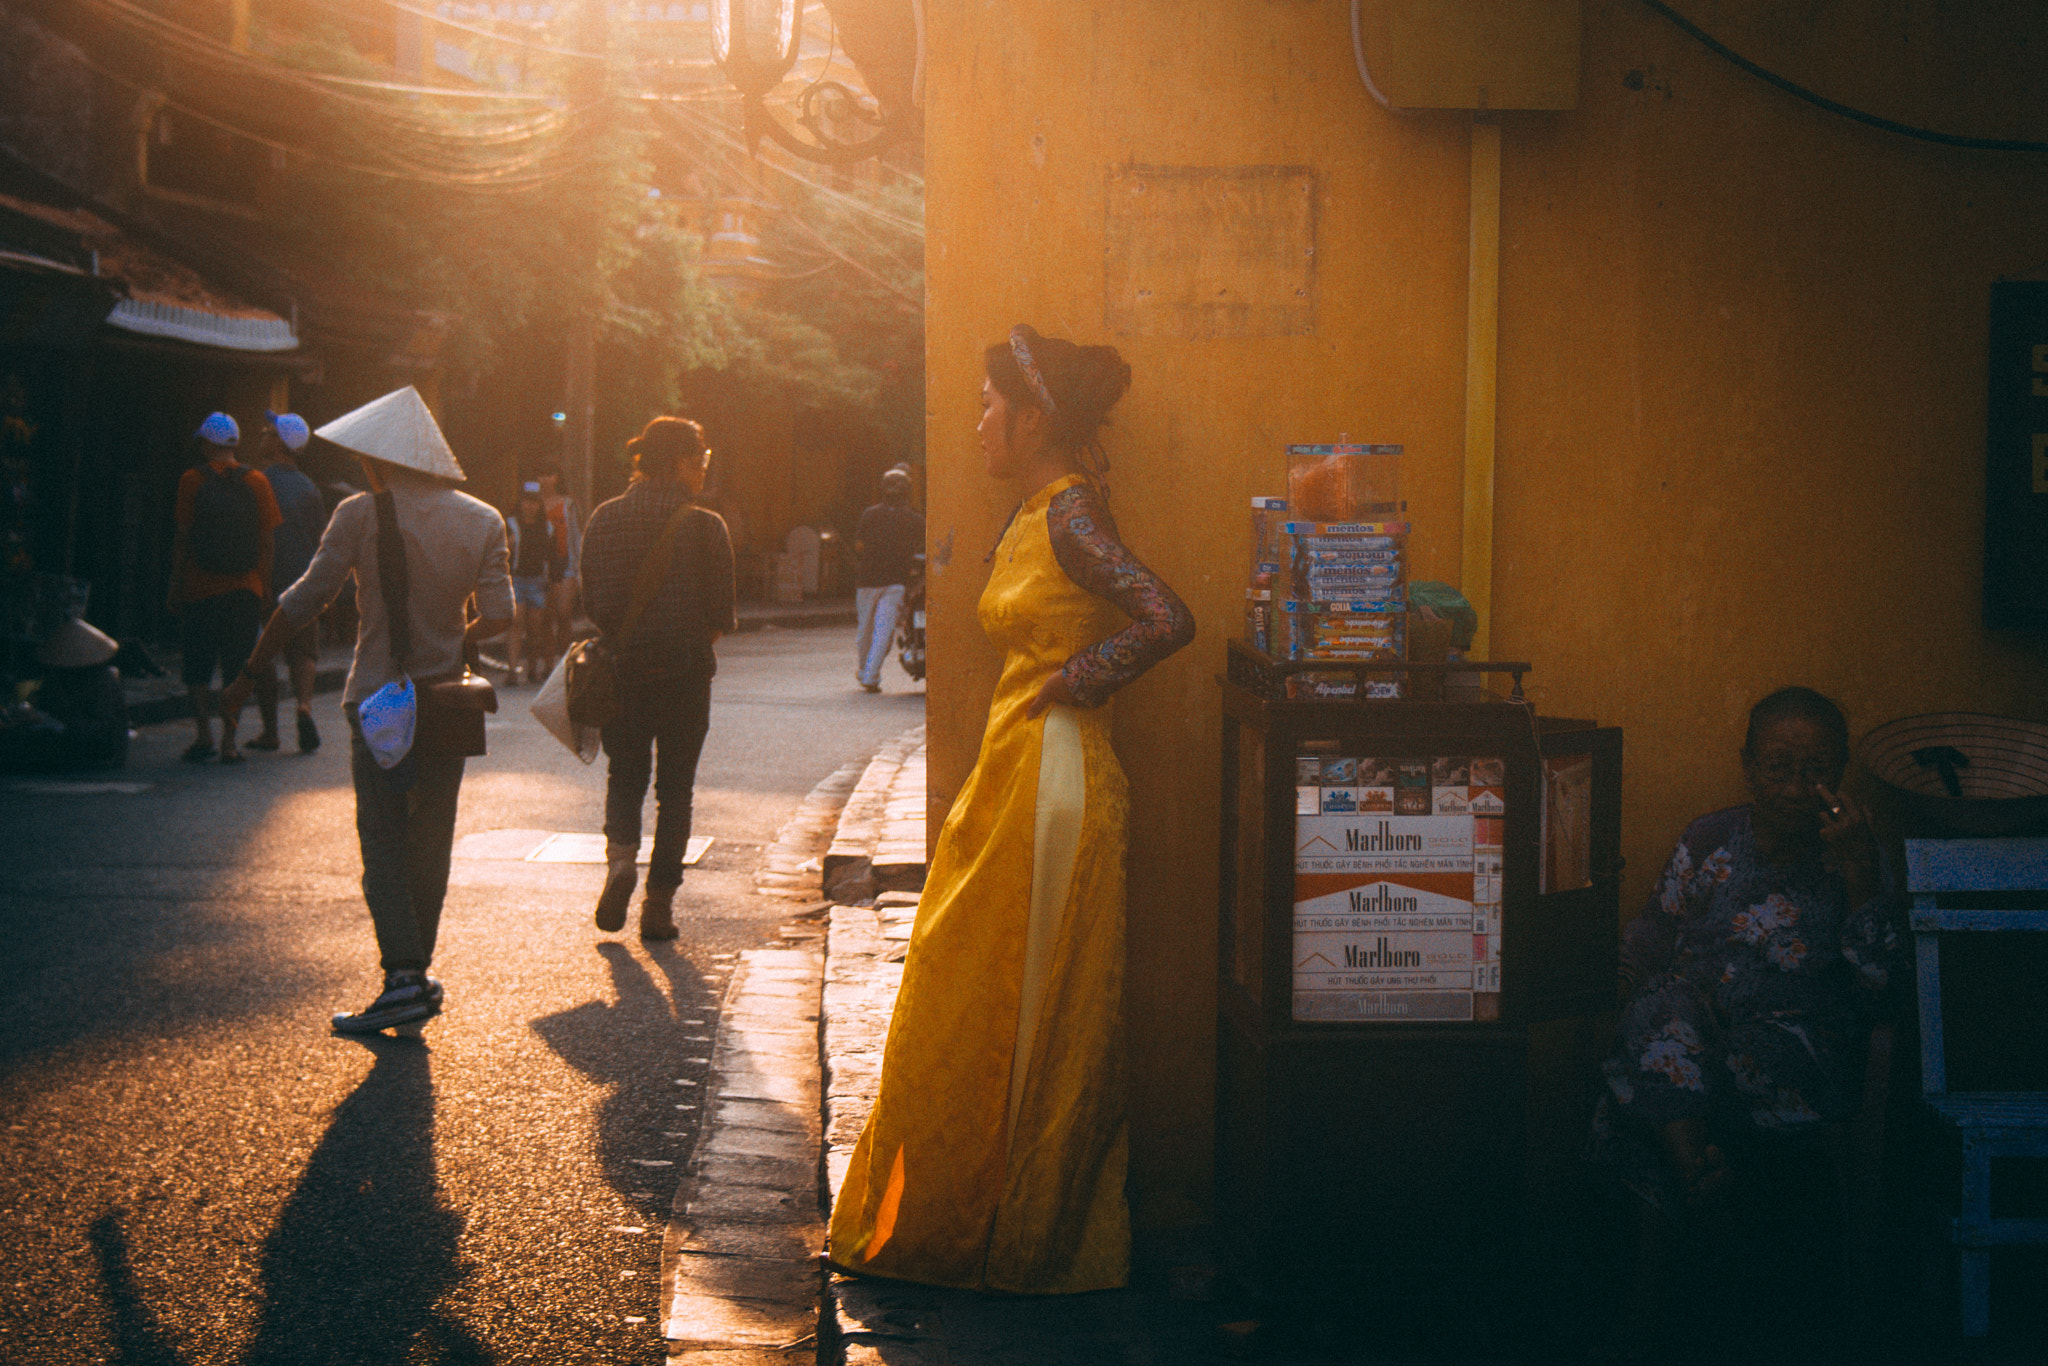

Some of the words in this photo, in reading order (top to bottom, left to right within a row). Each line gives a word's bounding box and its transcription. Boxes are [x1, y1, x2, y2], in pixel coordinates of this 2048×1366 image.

[1326, 524, 1374, 533] mentos
[1338, 551, 1385, 560] mentos
[1324, 566, 1371, 575] mentos
[1330, 602, 1351, 612] GOLIA
[1439, 800, 1466, 812] Marlboro
[1472, 800, 1502, 812] Marlboro
[1345, 821, 1422, 851] Marlboro
[1311, 859, 1334, 870] THUỐC
[1336, 859, 1350, 869] GÂY
[1349, 884, 1418, 912] Marlboro
[1310, 918, 1332, 927] THUỐC
[1335, 918, 1349, 927] GÂY
[1344, 937, 1420, 968] Marlboro
[1328, 977, 1341, 985] HÚT
[1345, 976, 1368, 985] THUỐC
[1370, 976, 1384, 985] GÂY
[1387, 976, 1401, 985] UNG
[1357, 994, 1408, 1014] Marlboro
